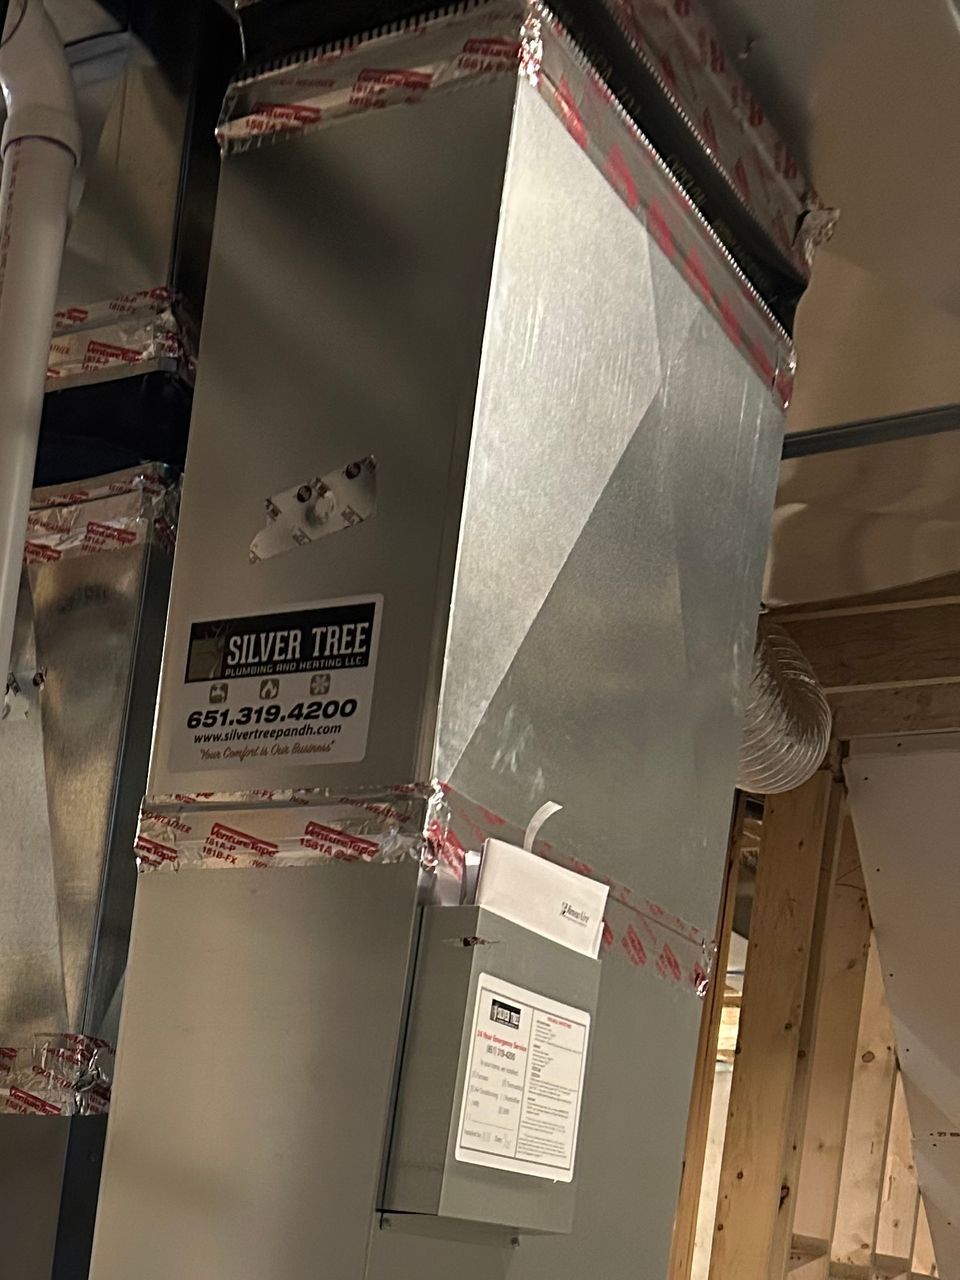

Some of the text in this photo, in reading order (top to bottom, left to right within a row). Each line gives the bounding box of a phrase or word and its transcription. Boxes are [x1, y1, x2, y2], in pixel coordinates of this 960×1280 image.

[226, 622, 370, 666] SILVER TREE
[225, 664, 274, 678] PLUMBING
[276, 661, 296, 673] AND
[299, 657, 342, 671] HEATING
[186, 698, 358, 730] 651.319.4200
[194, 723, 342, 744] www.silvertreepandh.com
[222, 746, 260, 762] Comfort
[260, 747, 269, 757] is
[270, 743, 290, 757] Our
[204, 837, 236, 853] 181A-P
[209, 822, 280, 858] VentureTape
[299, 838, 333, 858] 1581A
[304, 821, 380, 858] VentureTape
[202, 846, 238, 865] 181B-FX
